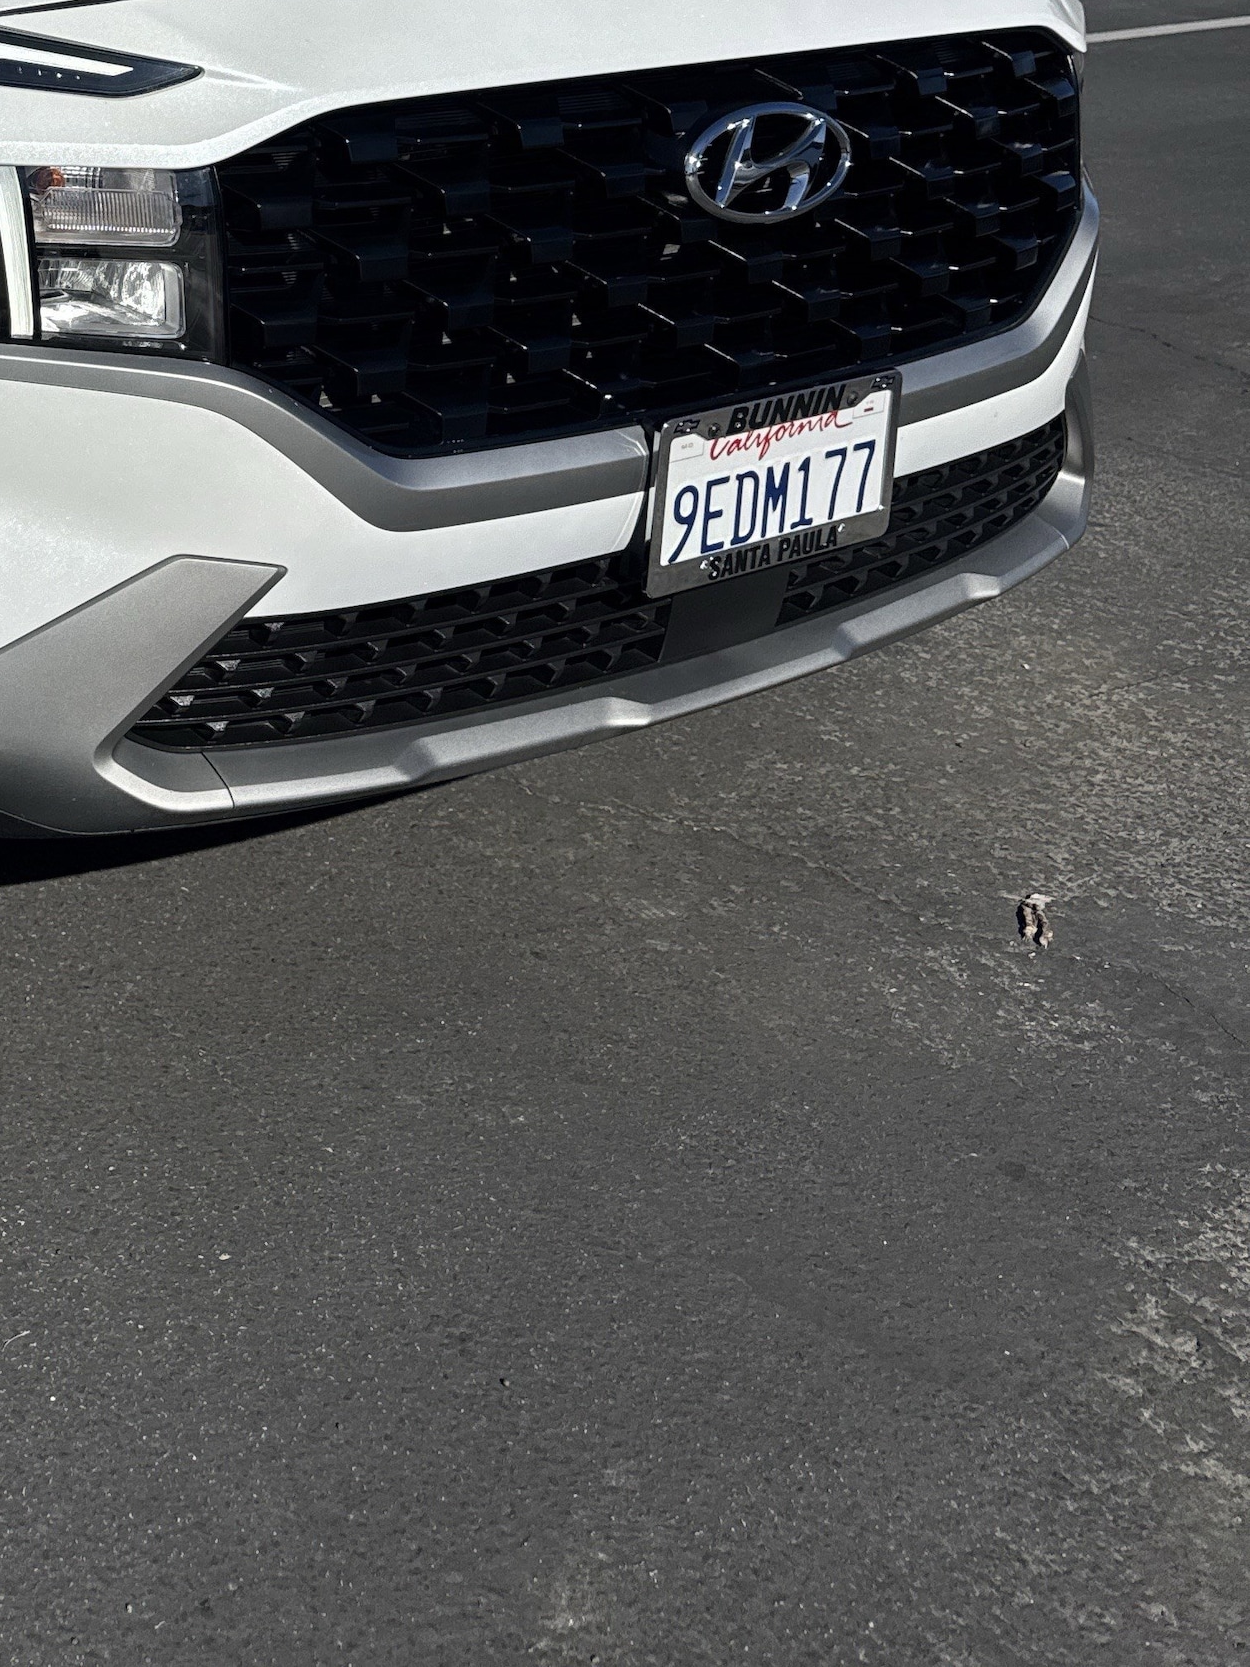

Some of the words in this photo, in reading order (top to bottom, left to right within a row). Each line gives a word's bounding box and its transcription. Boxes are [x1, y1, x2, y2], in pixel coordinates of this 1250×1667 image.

[725, 383, 848, 436] BUNNIN
[668, 438, 877, 564] 9EDM177
[708, 542, 771, 581] SANTA
[777, 524, 838, 563] PAULA
